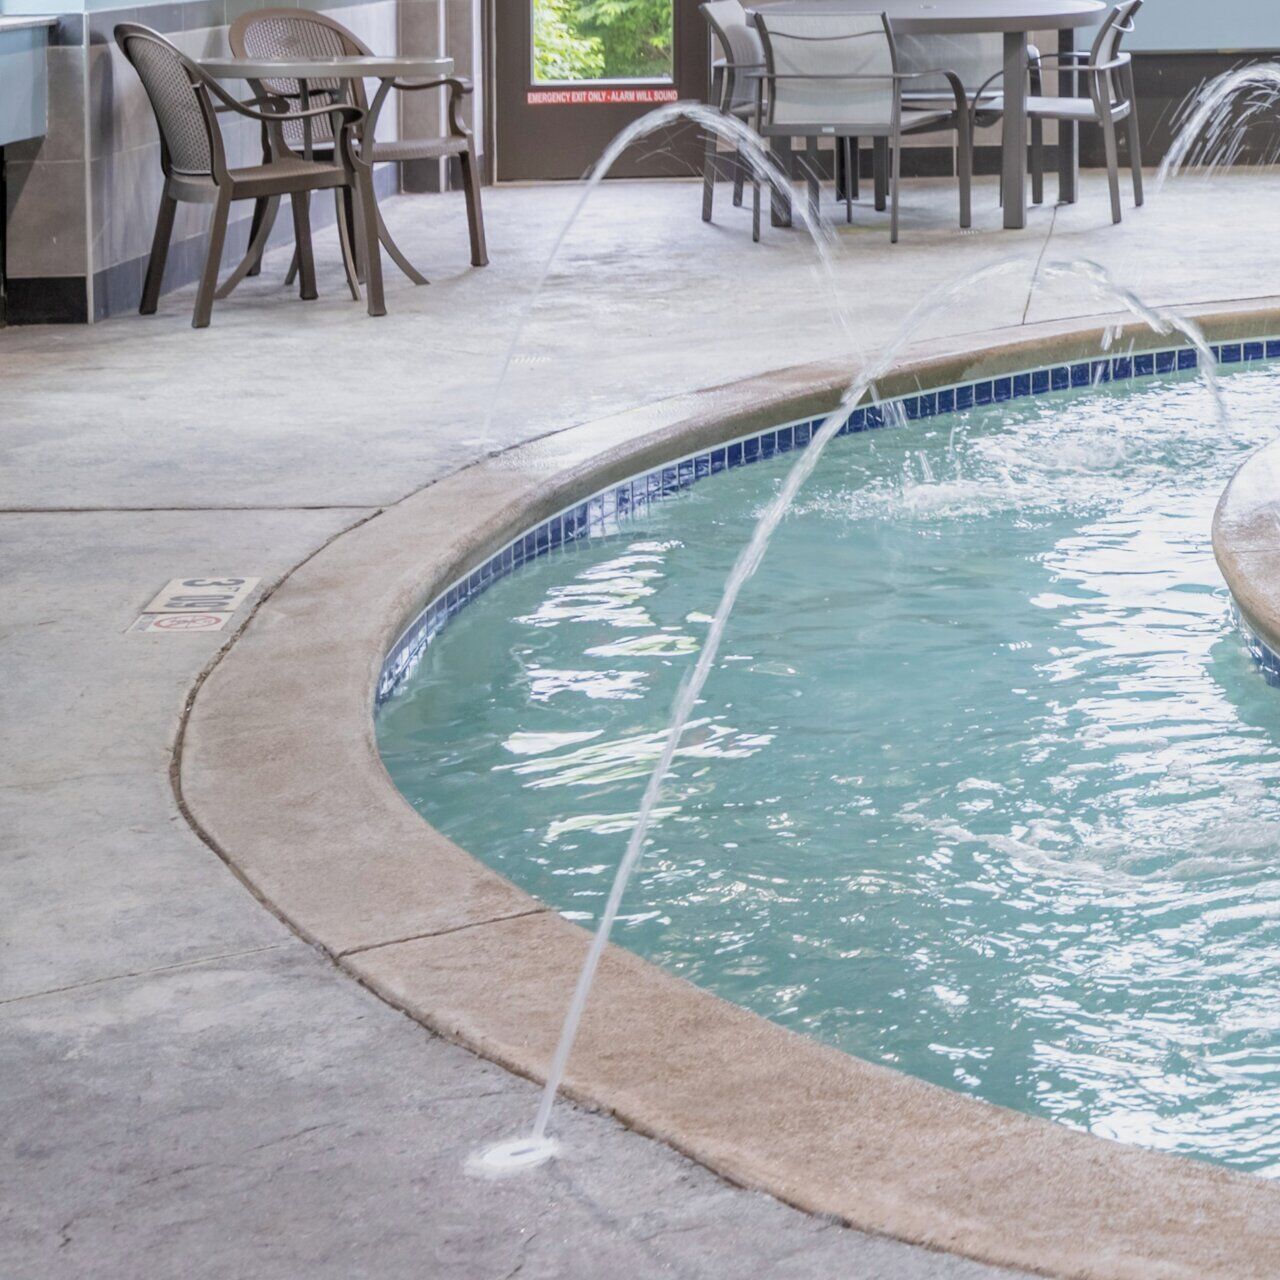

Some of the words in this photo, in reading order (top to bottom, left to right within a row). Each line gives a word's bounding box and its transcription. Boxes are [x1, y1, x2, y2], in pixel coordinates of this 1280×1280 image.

[527, 91, 571, 105] EMERGENCY
[571, 91, 588, 103] EXIT
[588, 90, 607, 103] ONLY
[611, 90, 636, 102] ALARM
[636, 90, 653, 102] WILL
[653, 89, 678, 101] SOUND
